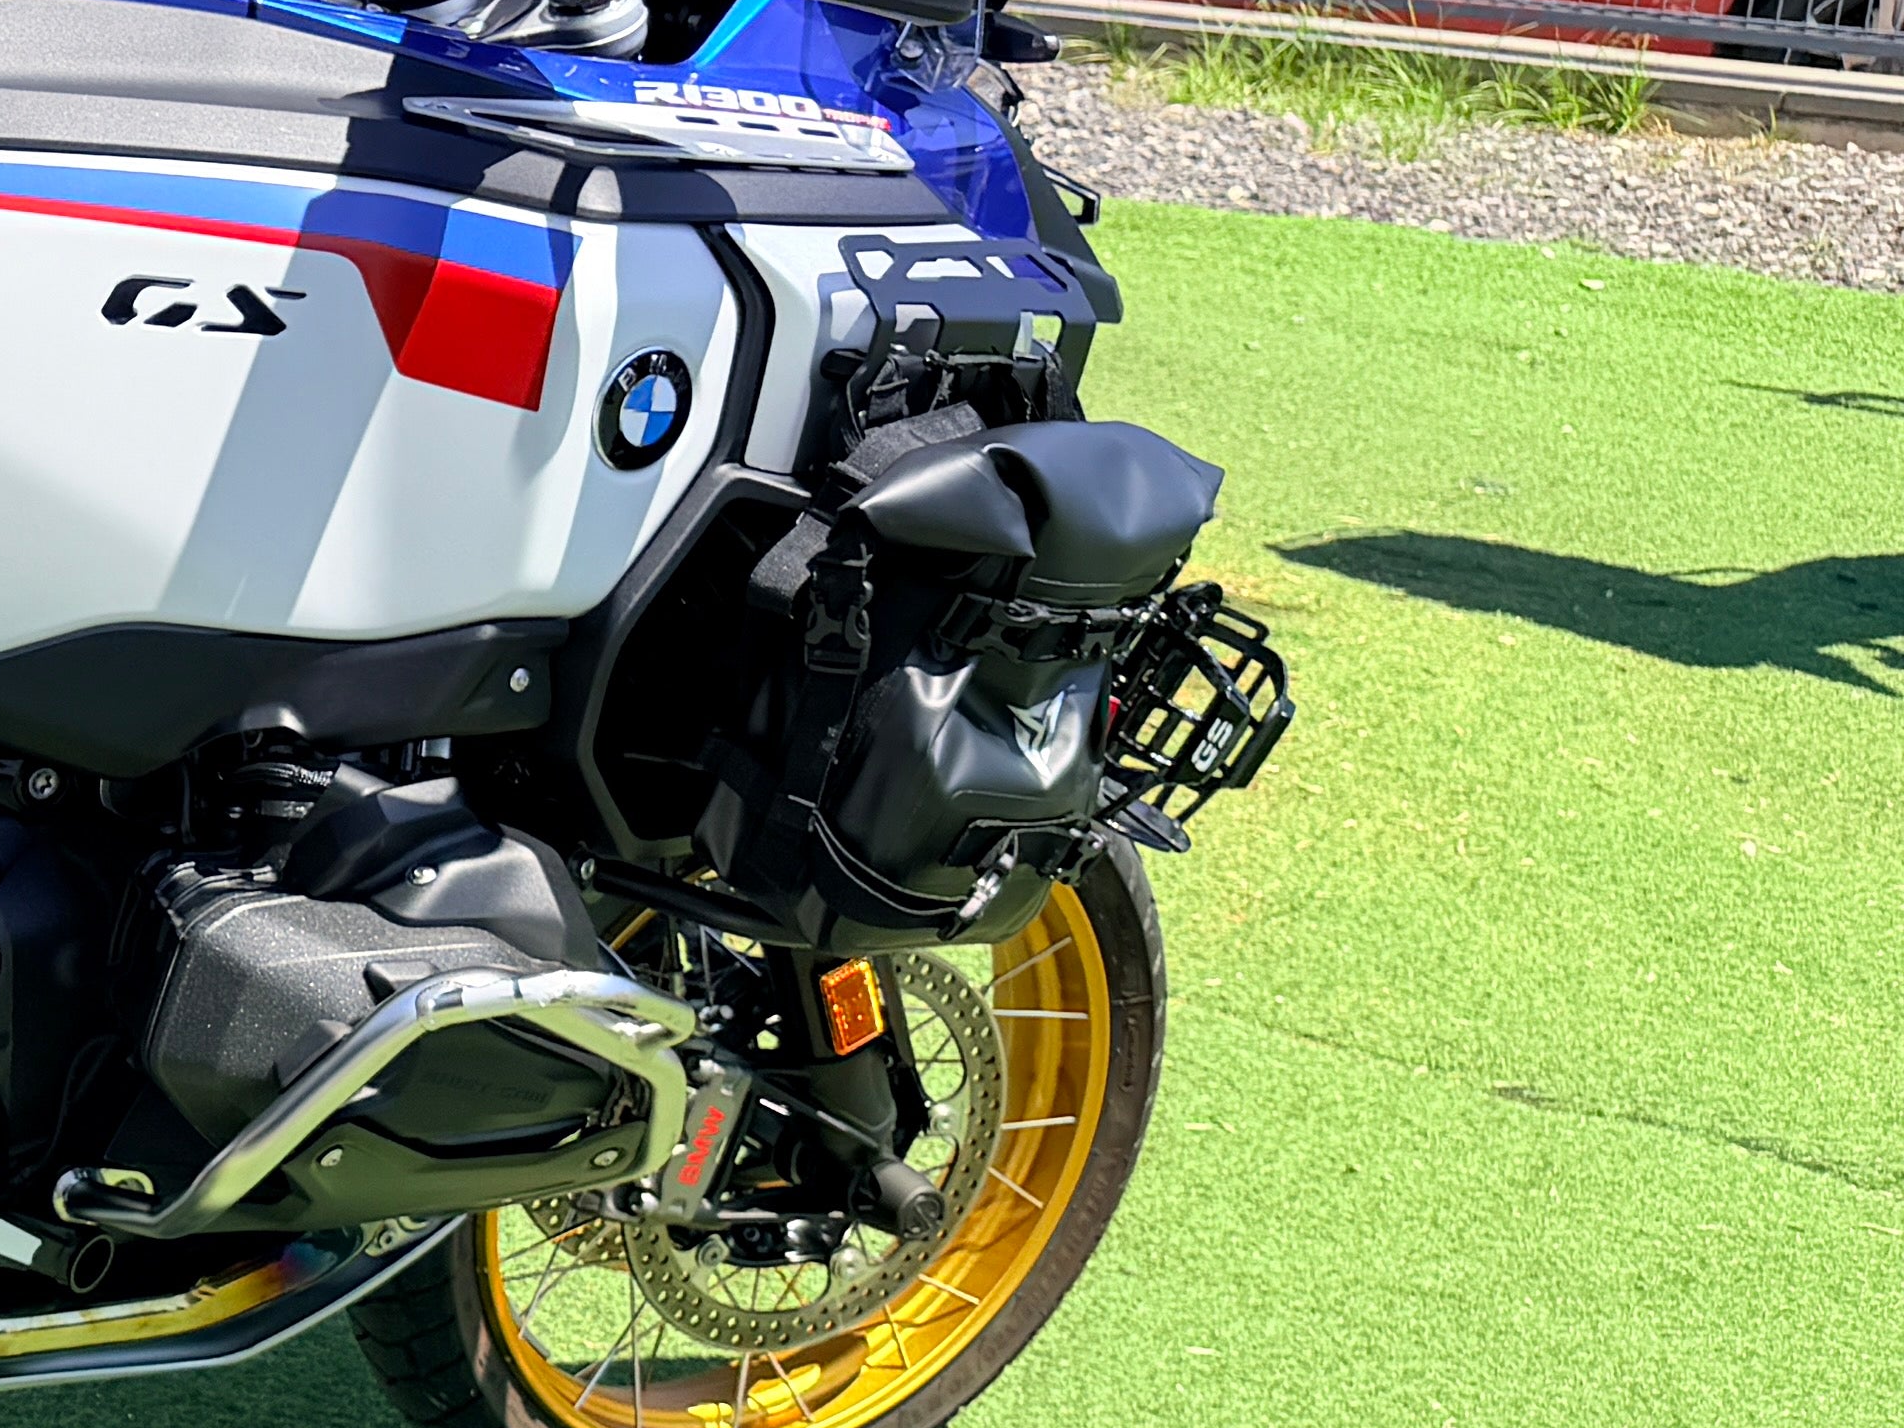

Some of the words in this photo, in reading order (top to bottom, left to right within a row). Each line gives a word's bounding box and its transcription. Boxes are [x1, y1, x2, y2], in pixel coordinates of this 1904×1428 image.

[100, 276, 308, 336] GS
[1190, 716, 1234, 773] GS
[677, 1104, 726, 1187] BMW
